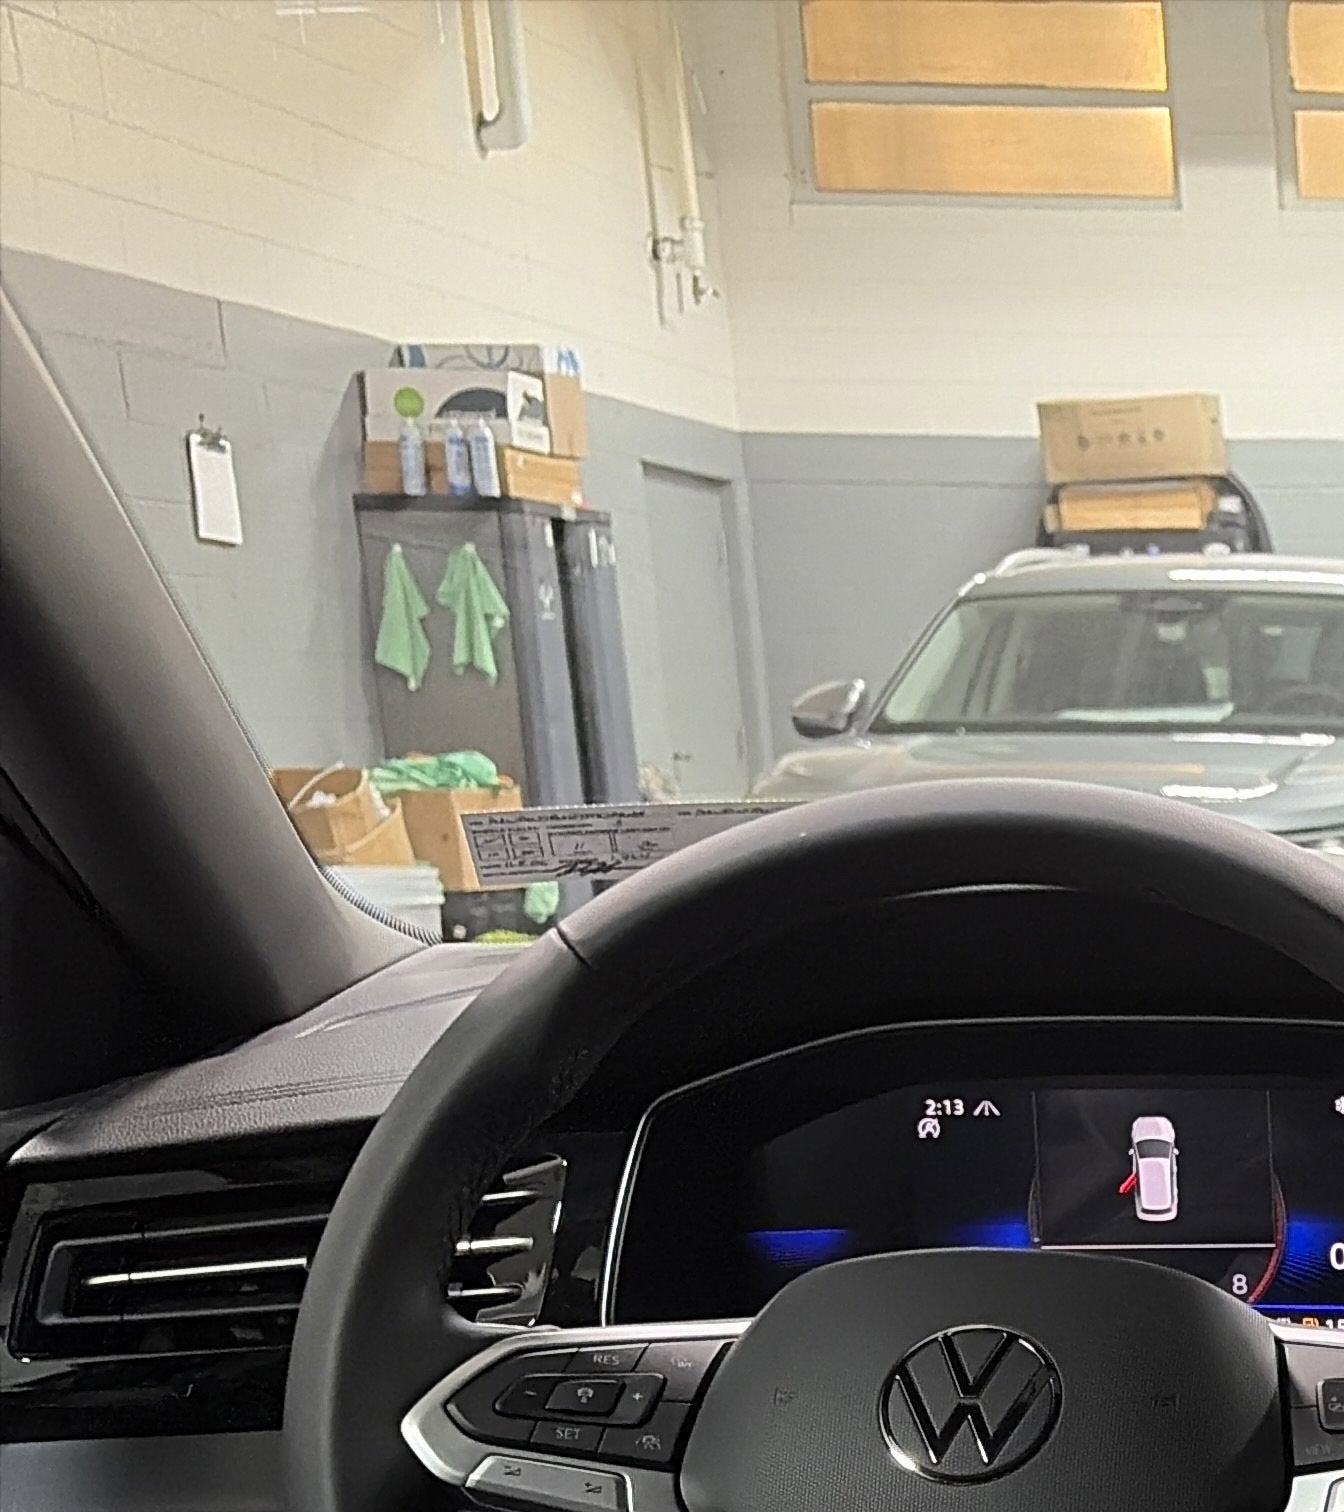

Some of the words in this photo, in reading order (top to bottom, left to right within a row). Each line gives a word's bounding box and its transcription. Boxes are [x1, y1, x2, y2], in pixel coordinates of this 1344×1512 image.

[924, 1098, 965, 1116] 2:13
[1232, 1274, 1248, 1296] 8
[592, 1353, 621, 1367] RES
[554, 1426, 581, 1441] SET
